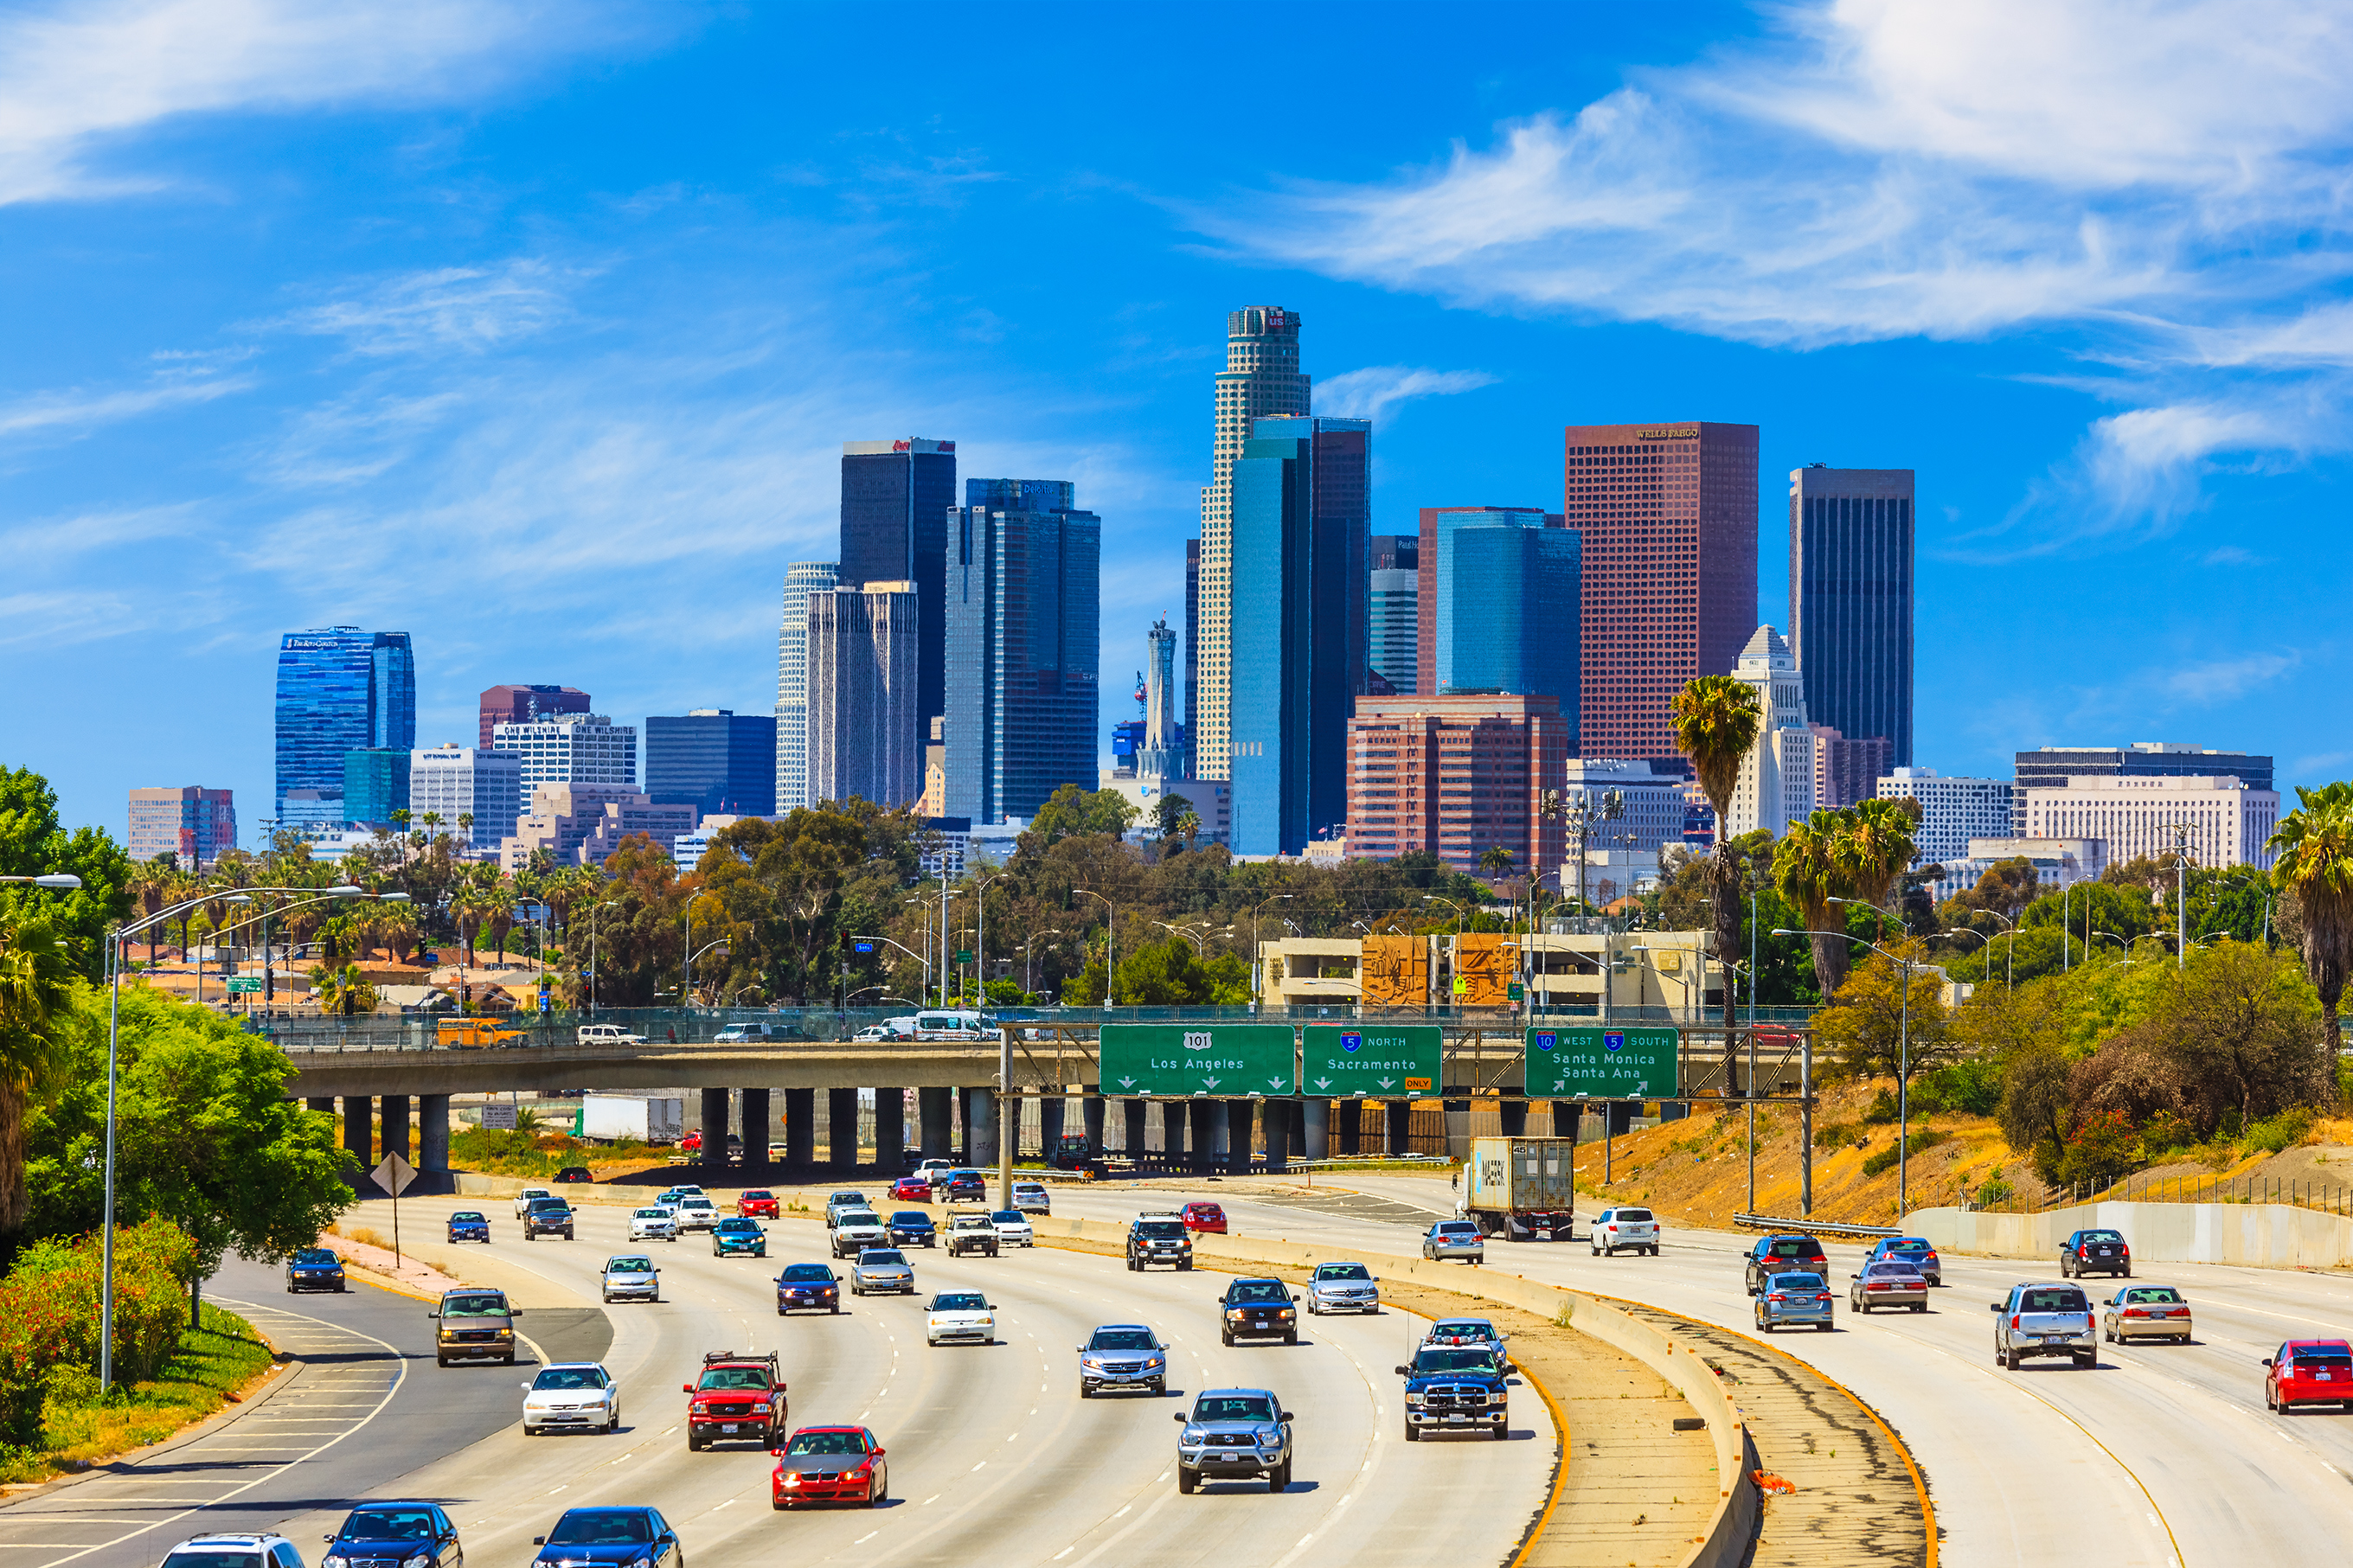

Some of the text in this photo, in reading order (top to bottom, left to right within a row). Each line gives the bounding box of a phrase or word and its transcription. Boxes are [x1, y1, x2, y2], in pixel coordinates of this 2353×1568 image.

[1269, 317, 1284, 326] us
[1398, 541, 1411, 549] Paul
[504, 726, 520, 735] ONE
[1189, 1036, 1208, 1046] 101
[1348, 1038, 1406, 1048] 5 NORTH
[1540, 1037, 1669, 1047] 10 WEST 5 SOUTH
[1553, 1053, 1655, 1065] Santa Monica
[1151, 1058, 1244, 1072] Los Angeles
[1328, 1059, 1416, 1070] Sacramento
[1562, 1067, 1640, 1078] Santa Ana
